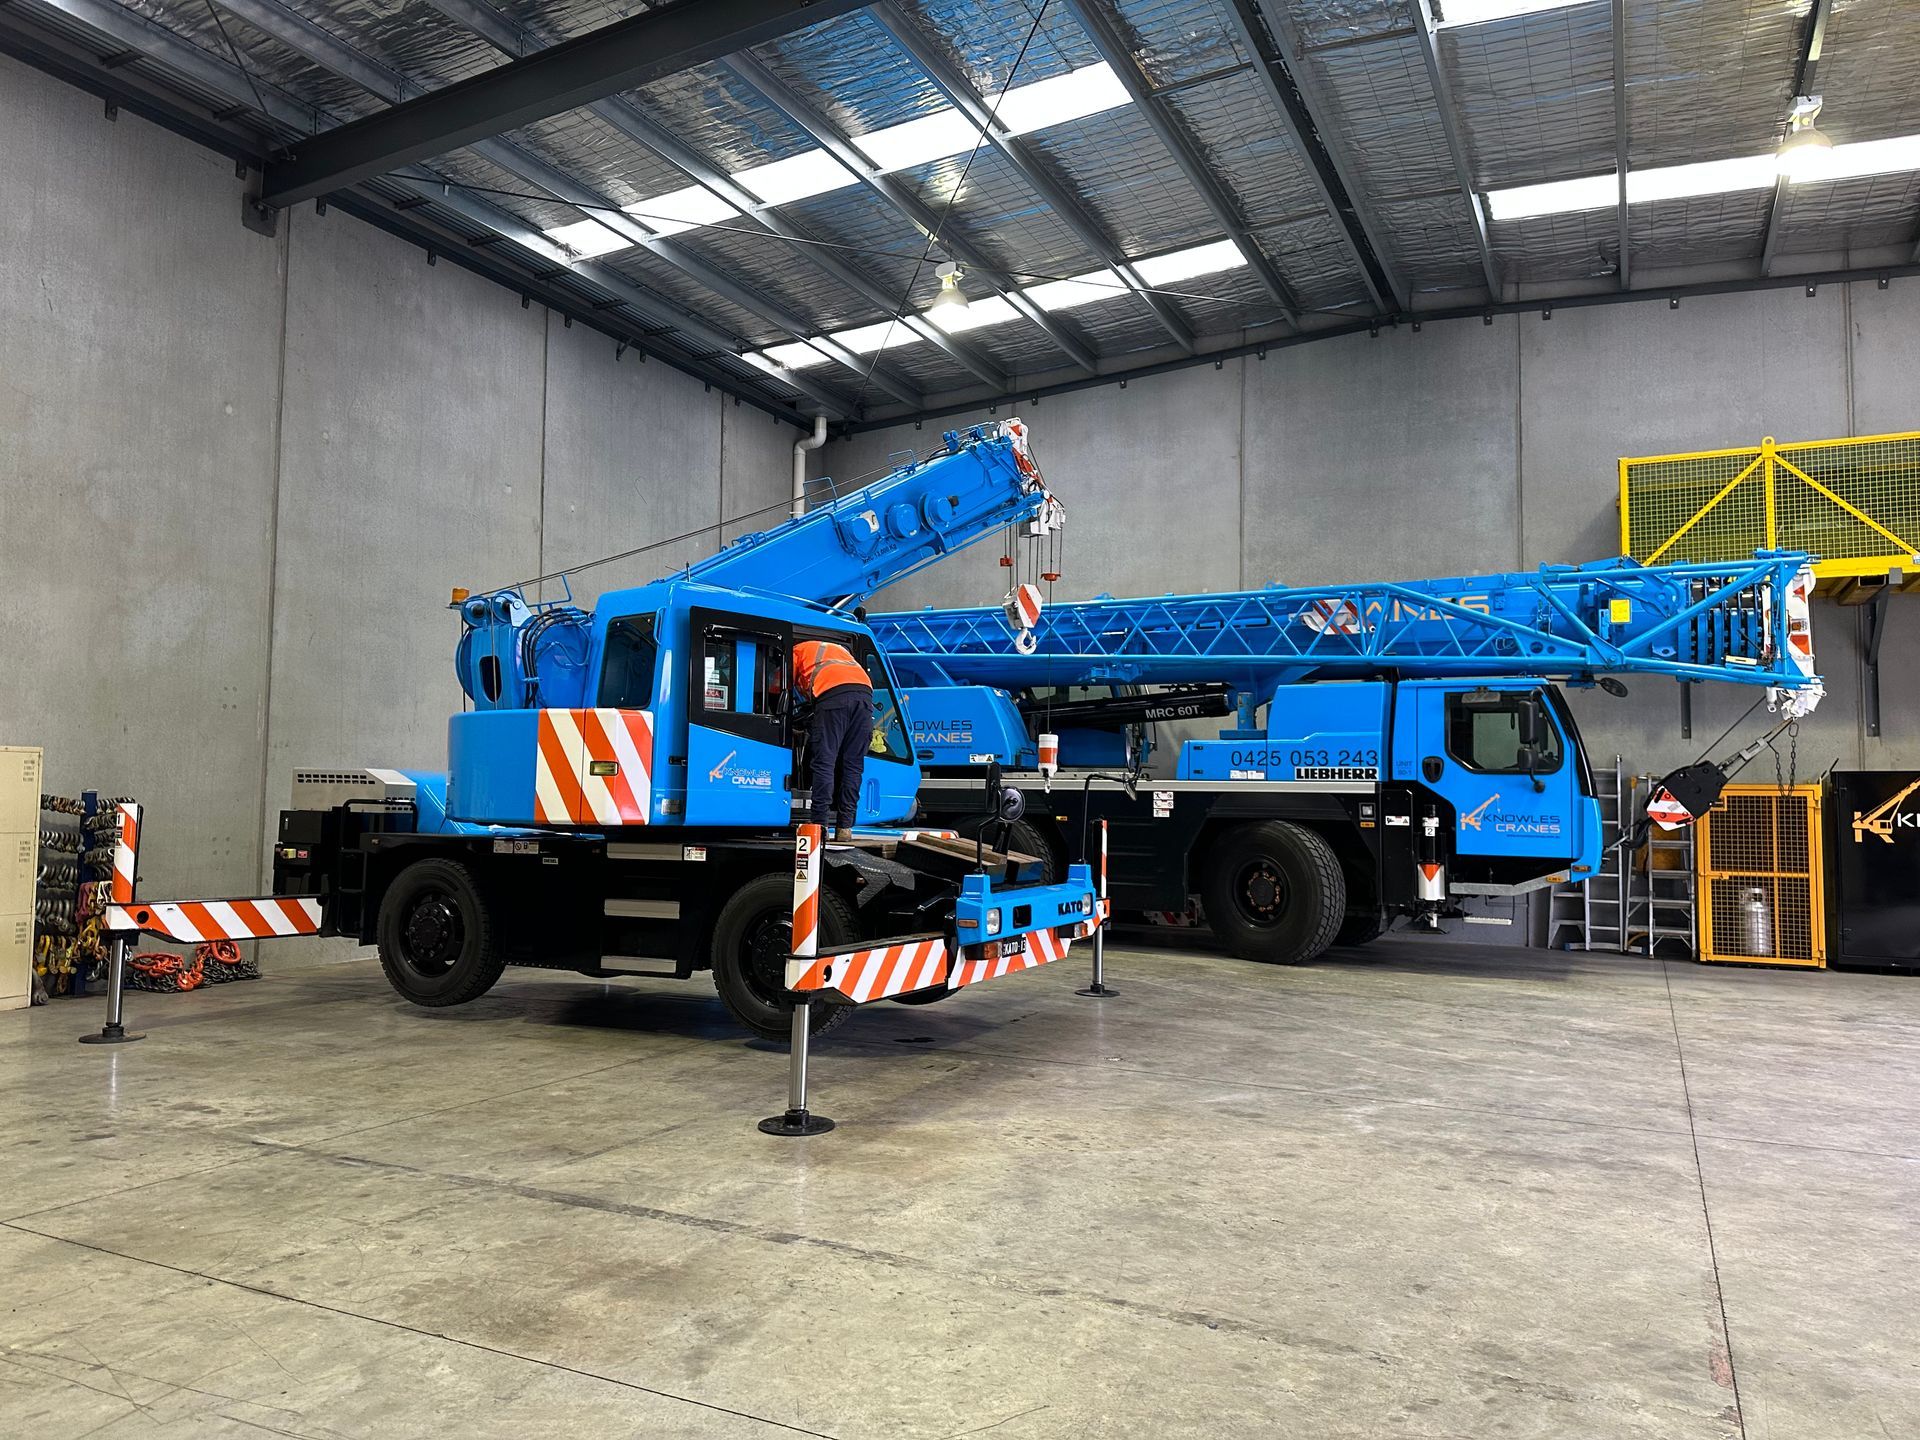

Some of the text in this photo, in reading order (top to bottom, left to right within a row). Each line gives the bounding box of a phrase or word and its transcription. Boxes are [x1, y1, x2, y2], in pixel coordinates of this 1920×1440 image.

[1145, 707, 1175, 719] MRC
[914, 732, 972, 743] RANES
[1231, 750, 1378, 767] 0425 053 243
[1295, 768, 1378, 780] LIEBHERR
[732, 776, 772, 786] CRANES
[1484, 814, 1561, 824] KNOWLES
[1495, 823, 1561, 834] CRANES
[798, 837, 807, 852] 2
[1058, 900, 1083, 916] KATO
